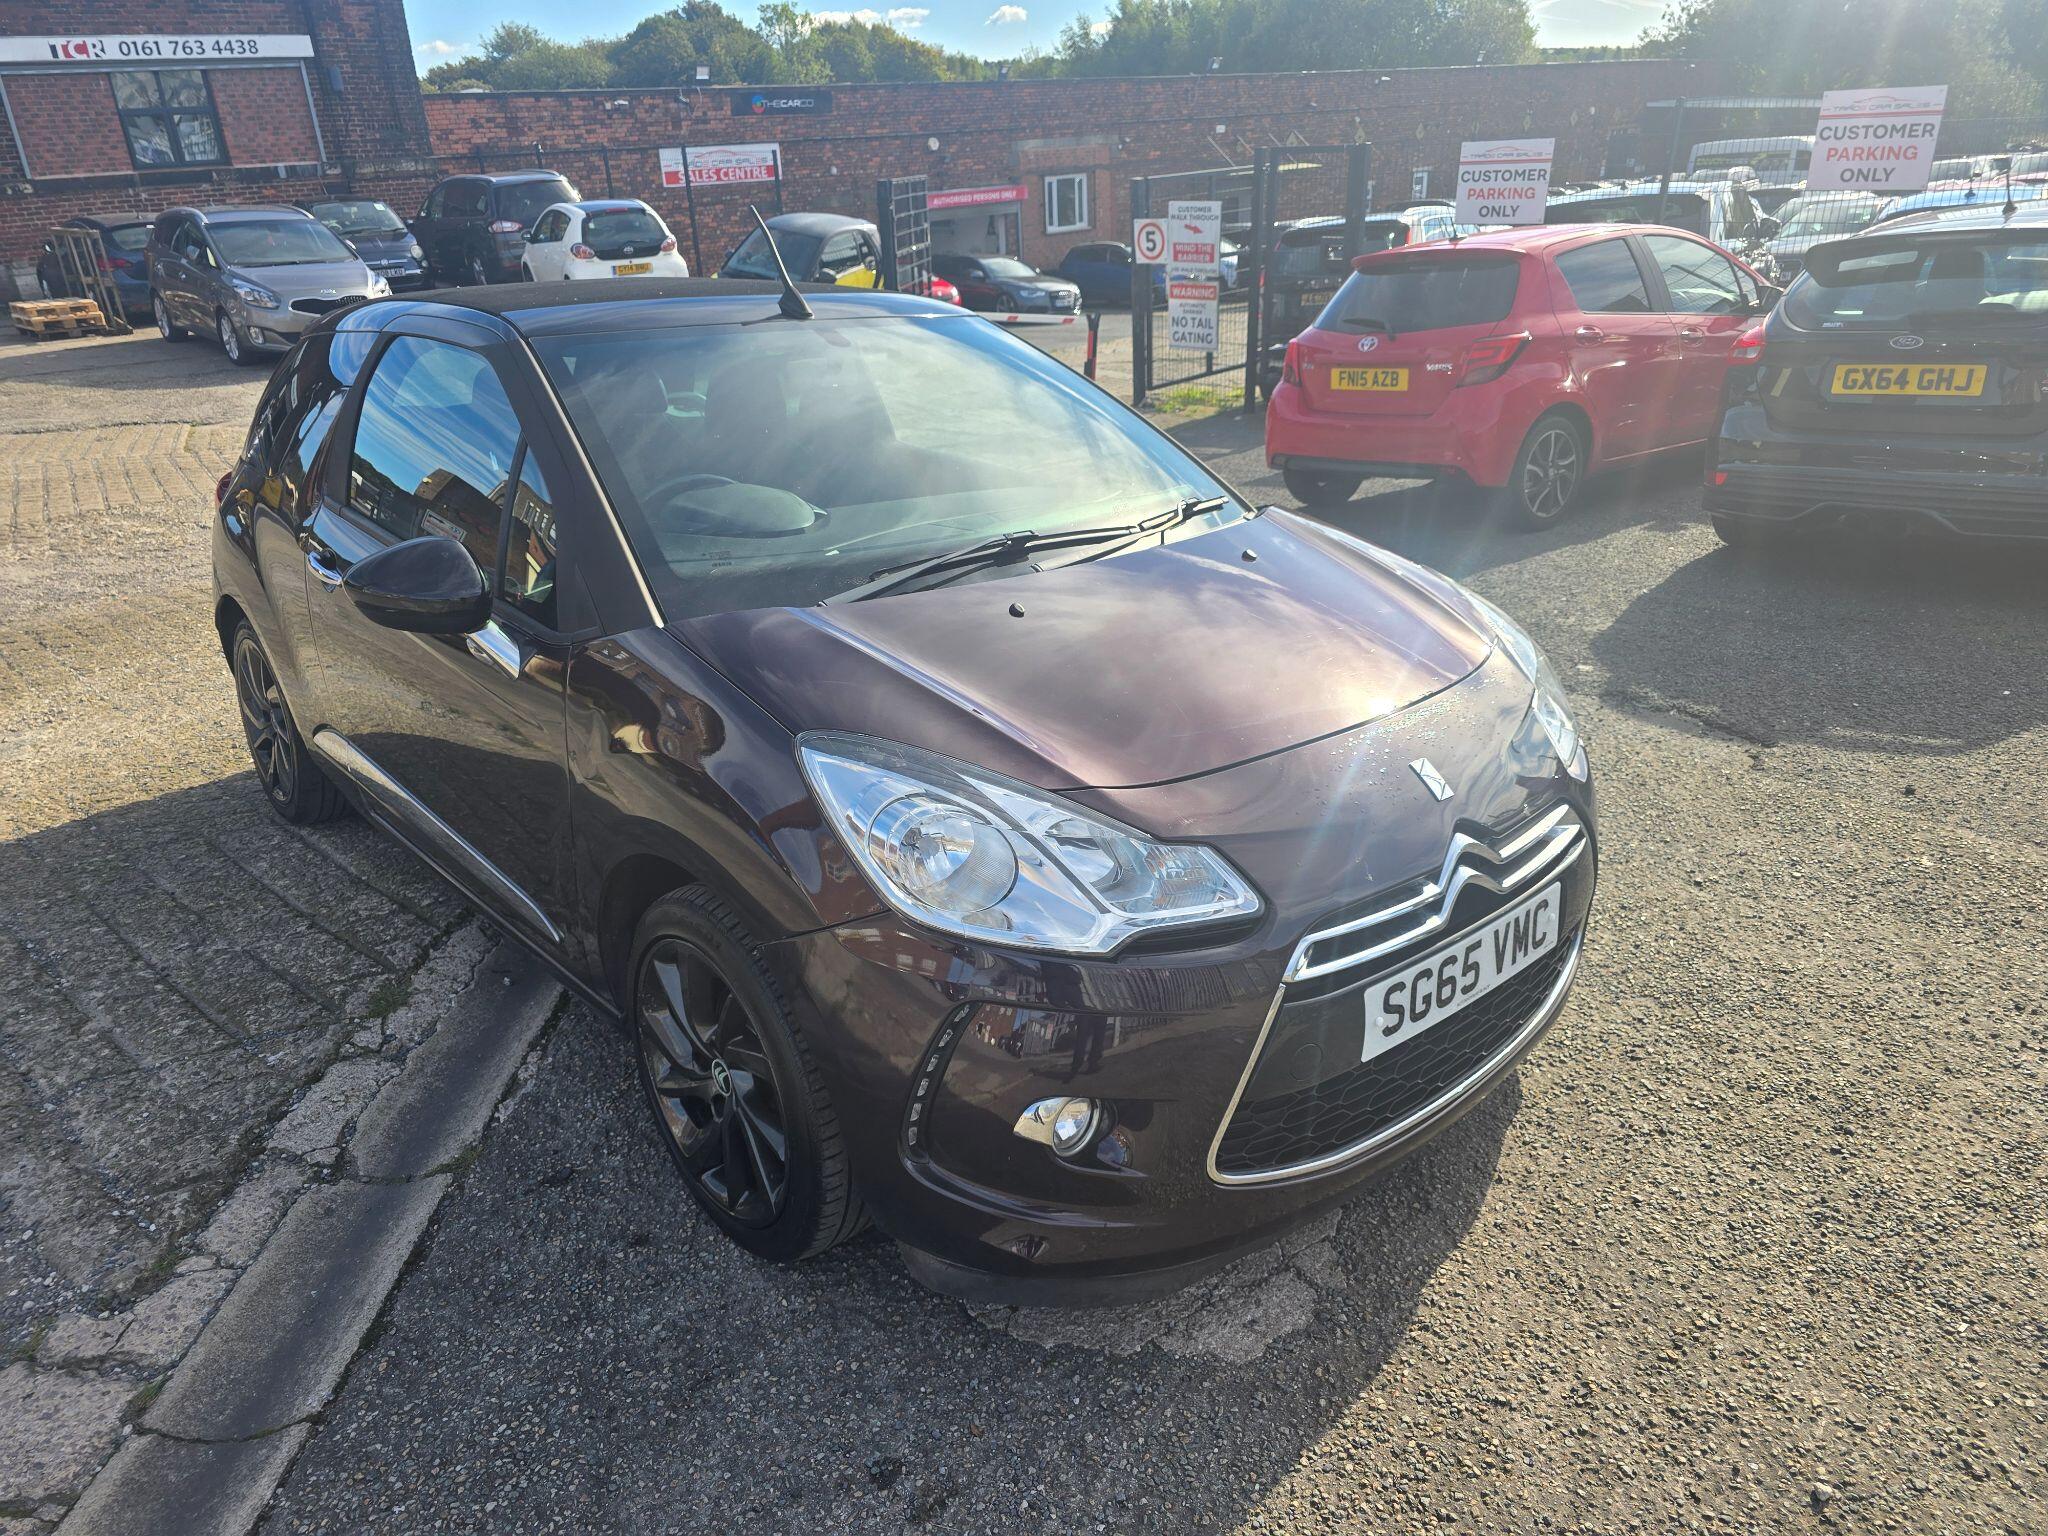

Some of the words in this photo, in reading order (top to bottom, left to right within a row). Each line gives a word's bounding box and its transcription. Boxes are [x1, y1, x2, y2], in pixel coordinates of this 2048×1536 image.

[118, 40, 162, 57] 0161
[168, 40, 205, 56] 763
[211, 39, 259, 55] 4438
[1819, 122, 1936, 141] CUSTOMER
[1826, 145, 1919, 162] PARKING
[678, 169, 718, 184] SALES
[720, 166, 768, 181] CENTRE
[1460, 168, 1548, 183] CUSTOMER
[1839, 167, 1897, 183] ONLY
[1467, 187, 1536, 201] PARKING
[1178, 205, 1212, 213] CUSTOMER
[1478, 205, 1521, 218] ONLY
[1145, 230, 1157, 252] 5
[1172, 287, 1215, 298] WARNING
[1171, 316, 1188, 328] NO
[1190, 317, 1214, 330] TAIL
[1172, 331, 1214, 344] GATING
[1338, 368, 1368, 388] FN15
[1371, 368, 1400, 388] AZB
[1842, 367, 1910, 391] GX64
[1916, 367, 1975, 392] GHJ
[1382, 938, 1482, 1038] SG65
[1493, 898, 1550, 976] VMC
